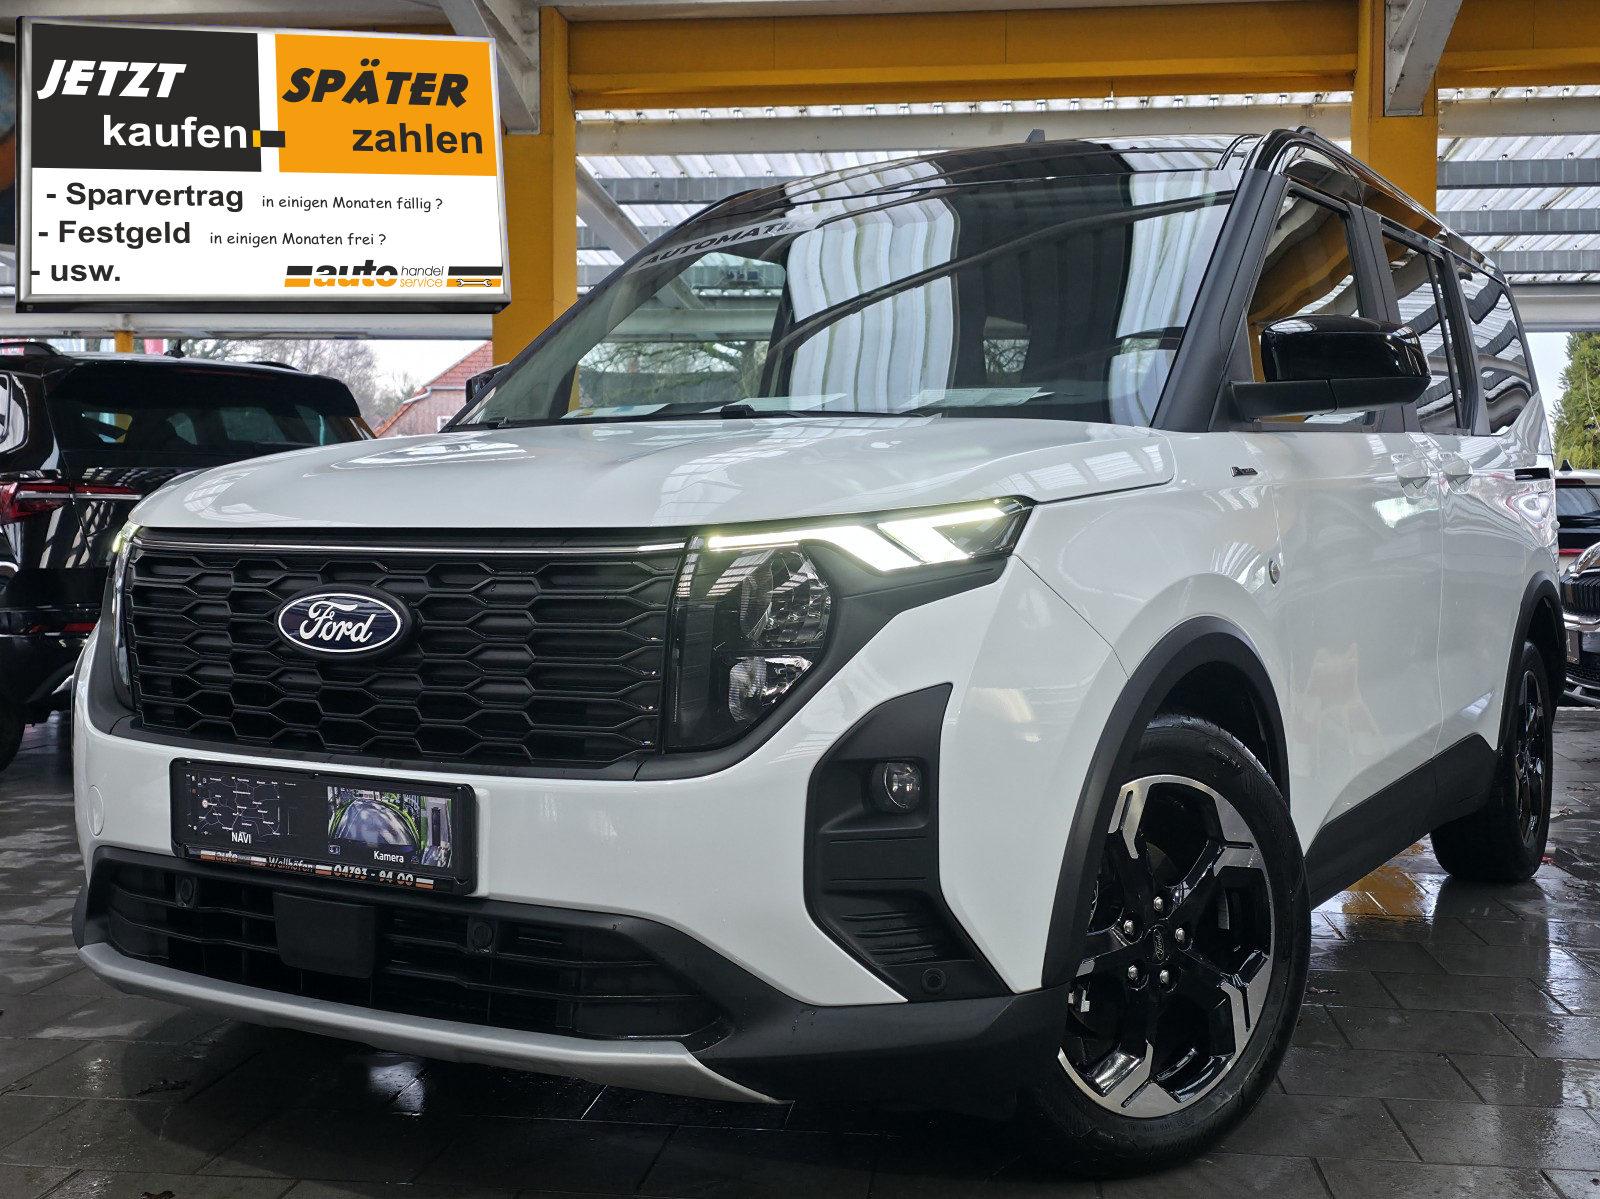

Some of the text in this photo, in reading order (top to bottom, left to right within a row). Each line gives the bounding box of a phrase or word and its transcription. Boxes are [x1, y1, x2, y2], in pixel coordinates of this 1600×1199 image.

[37, 59, 187, 100] JETZT
[282, 58, 469, 108] SPÄTER
[103, 114, 247, 149] kaufen
[352, 123, 483, 154] zahlen
[66, 182, 243, 213] Sparvertrag
[262, 196, 274, 207] in
[278, 197, 328, 212] einigen
[332, 197, 393, 210] Monaten
[396, 197, 431, 213] fällig
[59, 220, 190, 249] Festgeld
[210, 232, 222, 244] in
[227, 233, 277, 248] einigen
[282, 233, 343, 246] Monaten
[347, 233, 374, 245] frei
[639, 222, 799, 268] AUTOMATI
[51, 264, 121, 282] usw.
[313, 259, 398, 287] auto
[399, 276, 443, 288] service
[401, 265, 444, 277] handel
[299, 600, 376, 643] Ford
[231, 832, 252, 844] NAVI
[373, 850, 404, 864] Kamera
[333, 864, 368, 880] 04793
